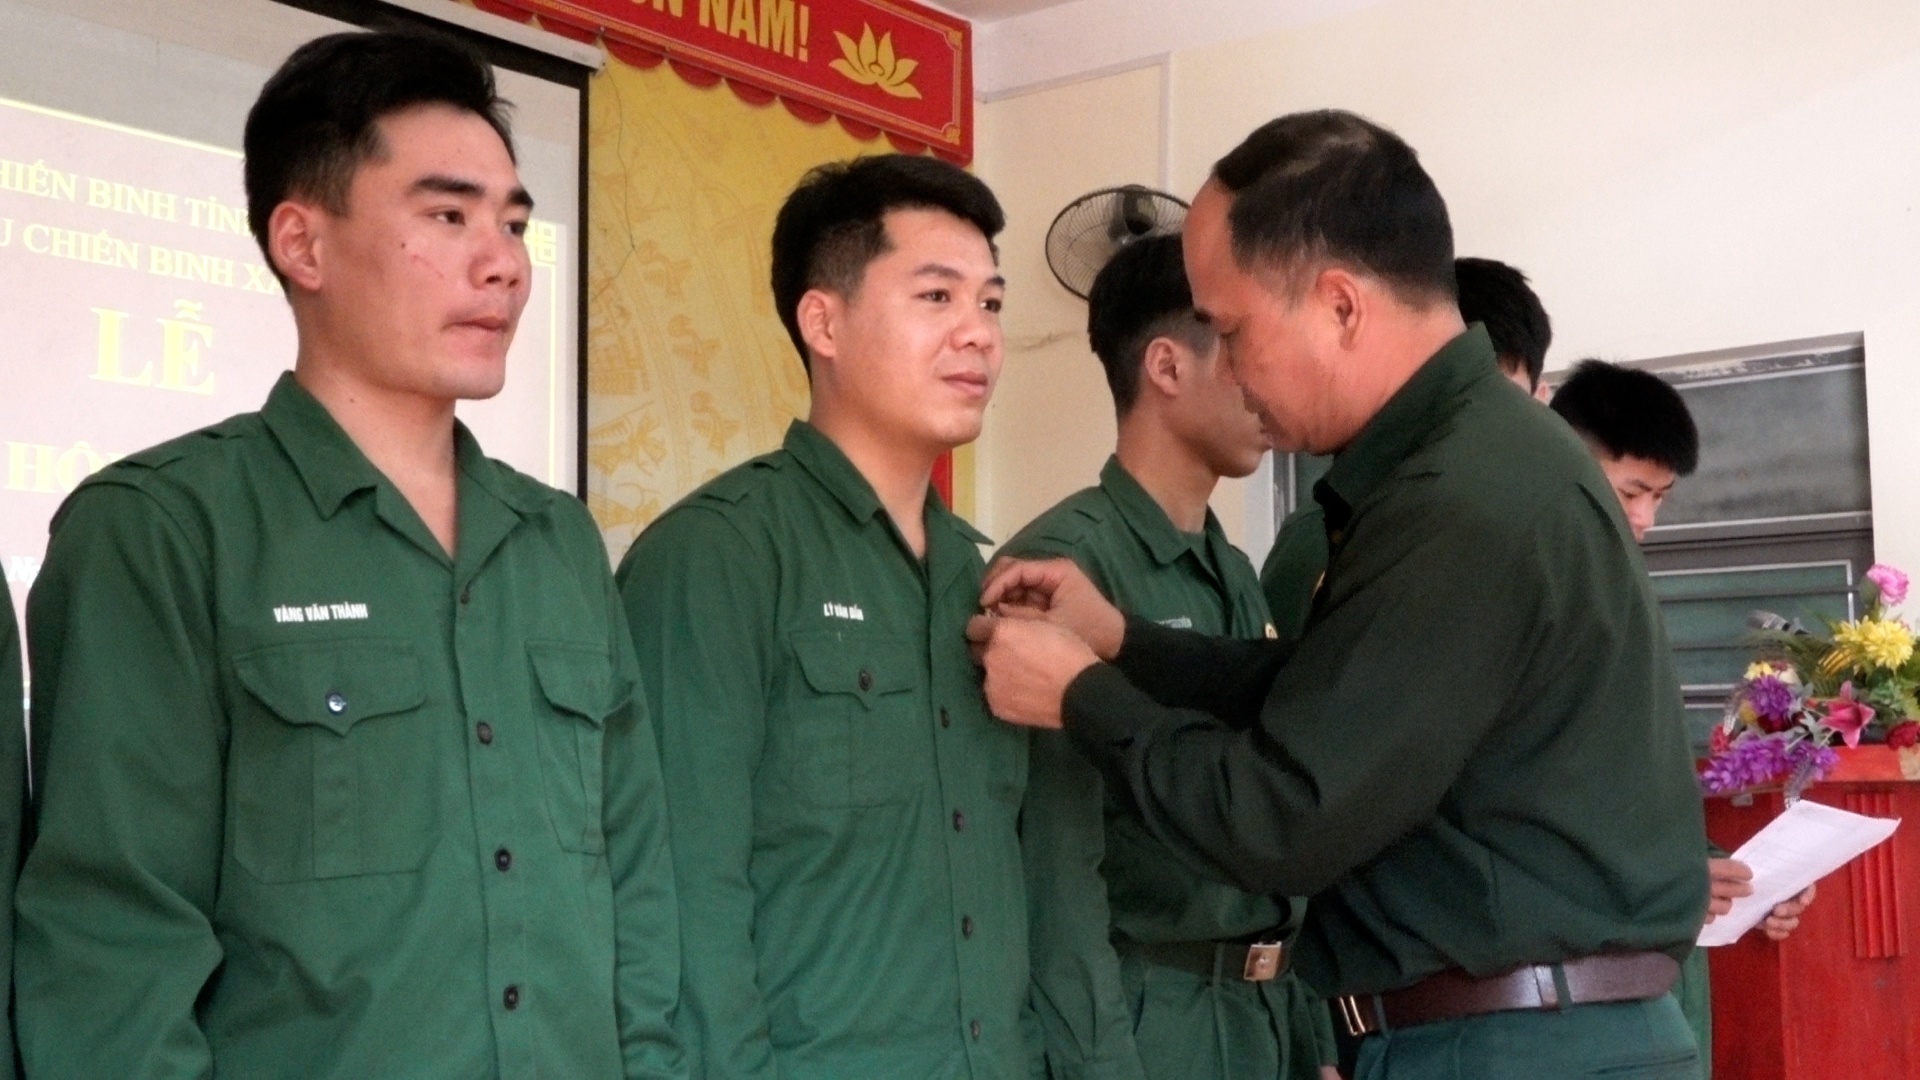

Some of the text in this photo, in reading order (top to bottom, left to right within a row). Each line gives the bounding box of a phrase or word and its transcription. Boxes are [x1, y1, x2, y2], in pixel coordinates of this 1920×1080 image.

[87, 177, 178, 223] BINH
[23, 224, 139, 270] CHIẾN
[148, 245, 235, 288] BINH
[88, 298, 215, 395] LỄ
[273, 601, 369, 623] VÀNG VĂN THÀNH
